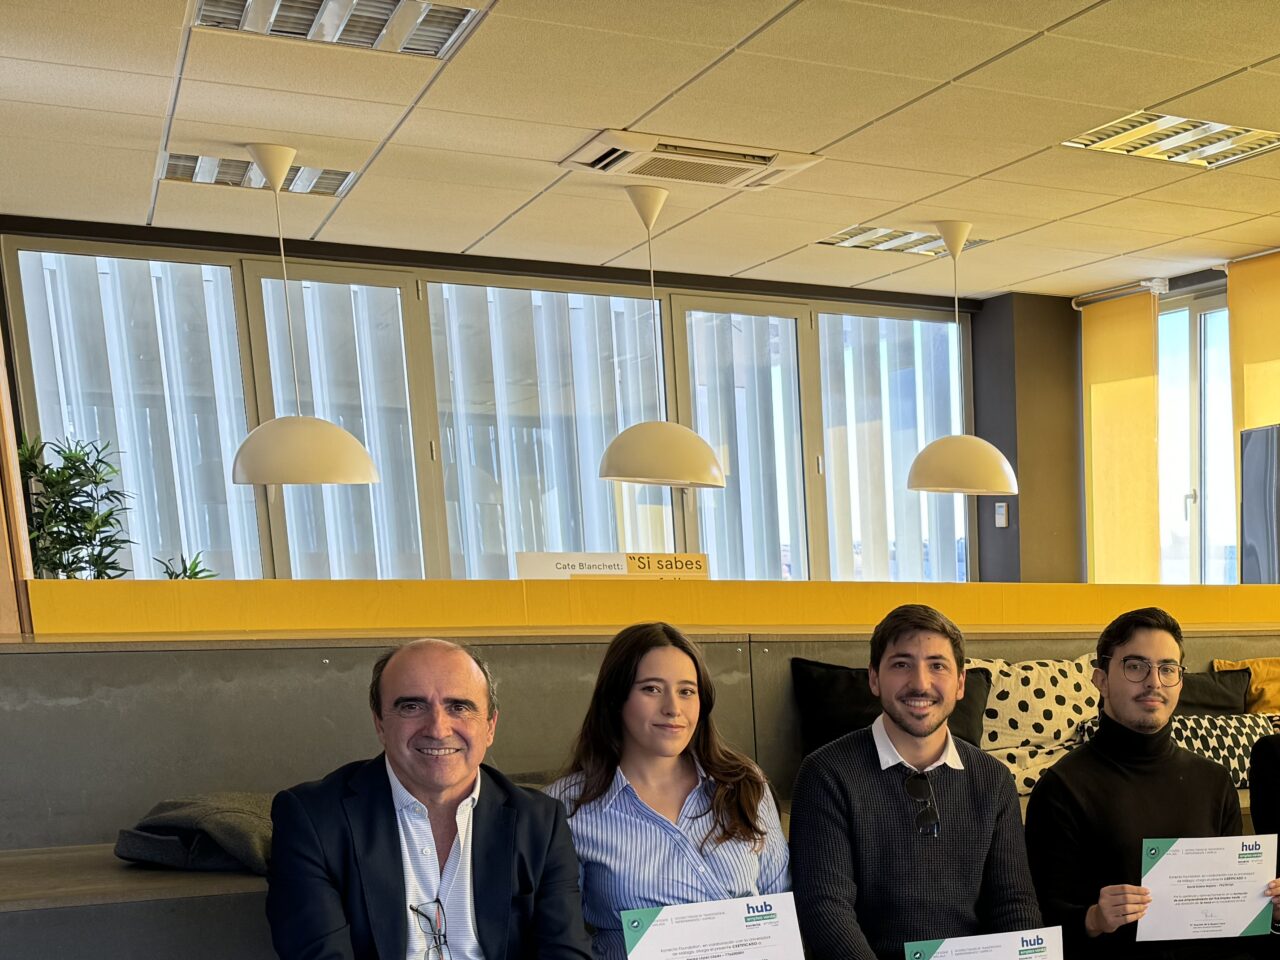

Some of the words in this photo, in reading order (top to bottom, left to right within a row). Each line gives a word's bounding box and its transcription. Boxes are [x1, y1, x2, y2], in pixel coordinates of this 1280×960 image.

[555, 562, 576, 570] Cate
[578, 562, 624, 571] Blanchett:
[656, 557, 703, 571] sabes
[1241, 841, 1261, 852] hub
[746, 901, 773, 915] hub
[1021, 935, 1044, 948] hub
